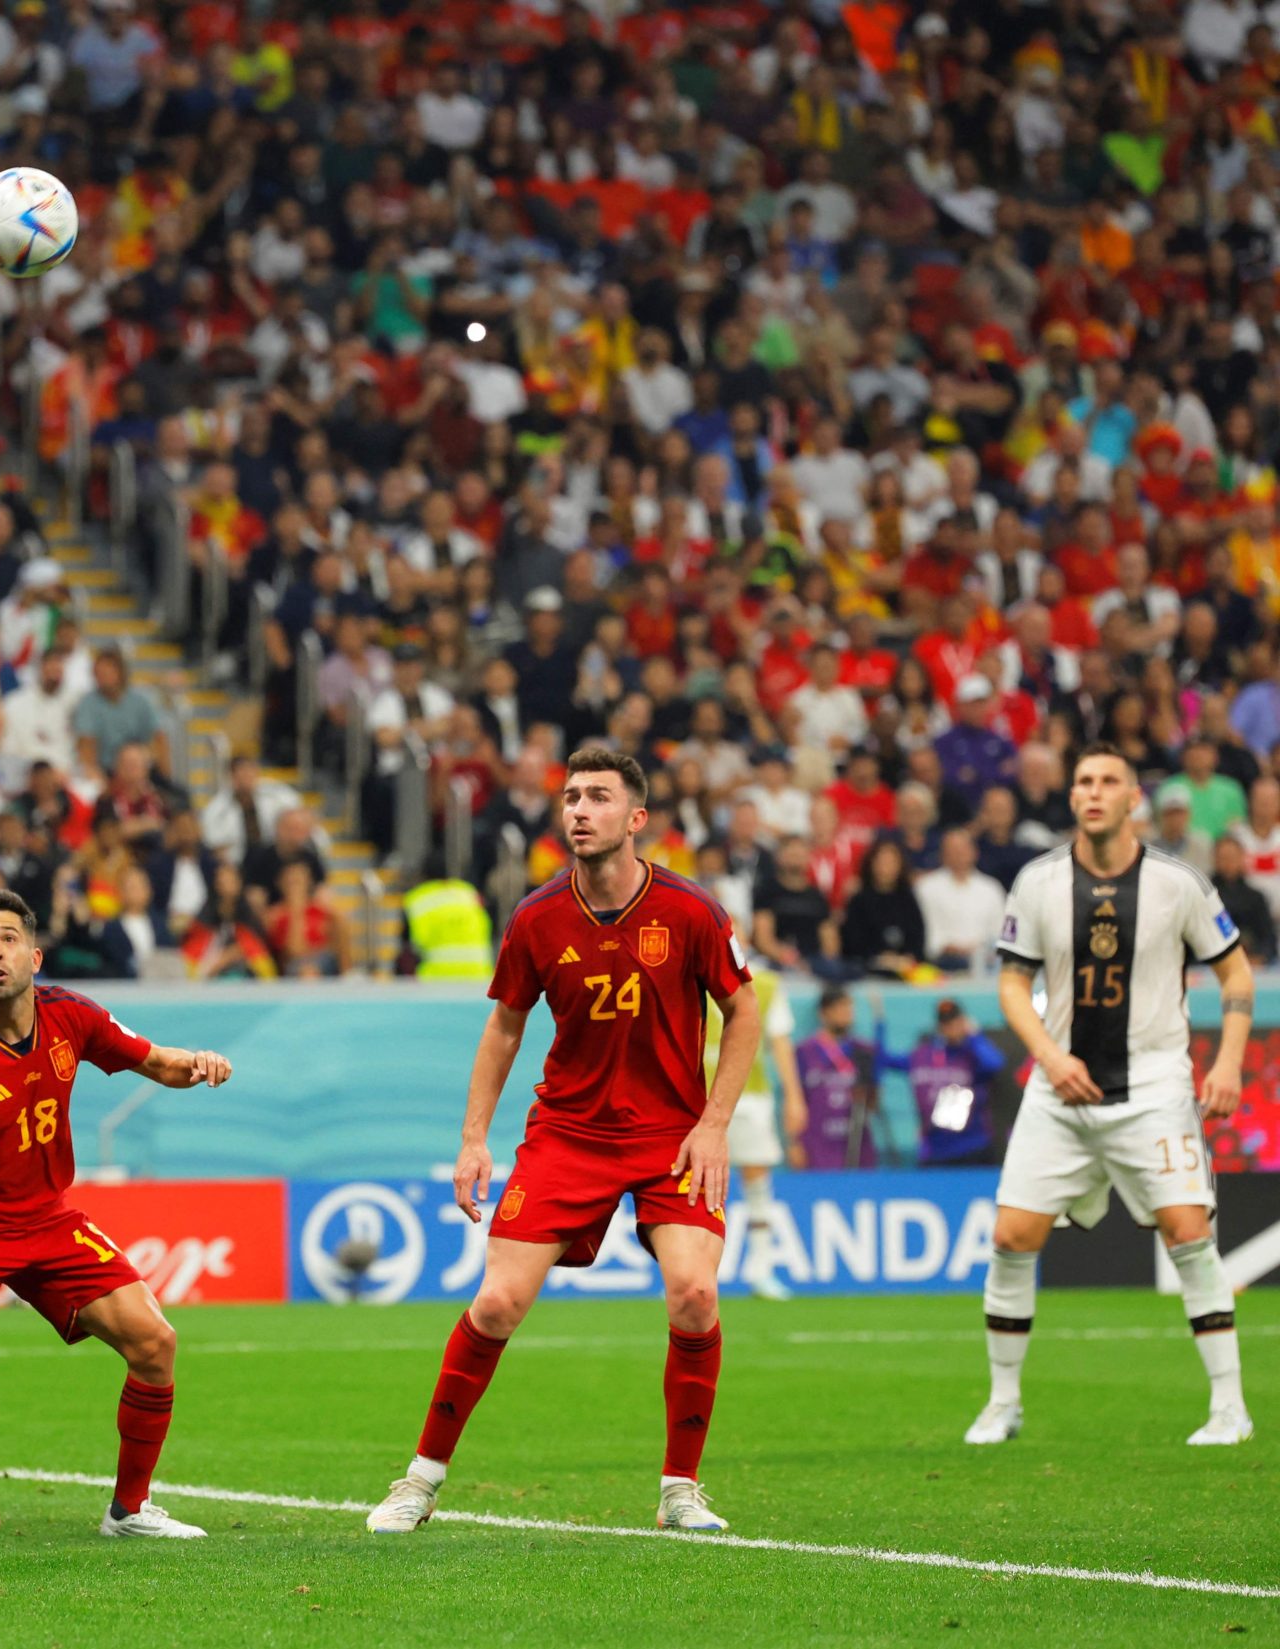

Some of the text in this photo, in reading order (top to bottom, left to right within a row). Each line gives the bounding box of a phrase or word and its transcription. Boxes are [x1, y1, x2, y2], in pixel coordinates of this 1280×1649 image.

[583, 972, 642, 1021] 24
[1077, 964, 1126, 1008] 15
[15, 1097, 58, 1153] 18
[1154, 1132, 1201, 1175] 15
